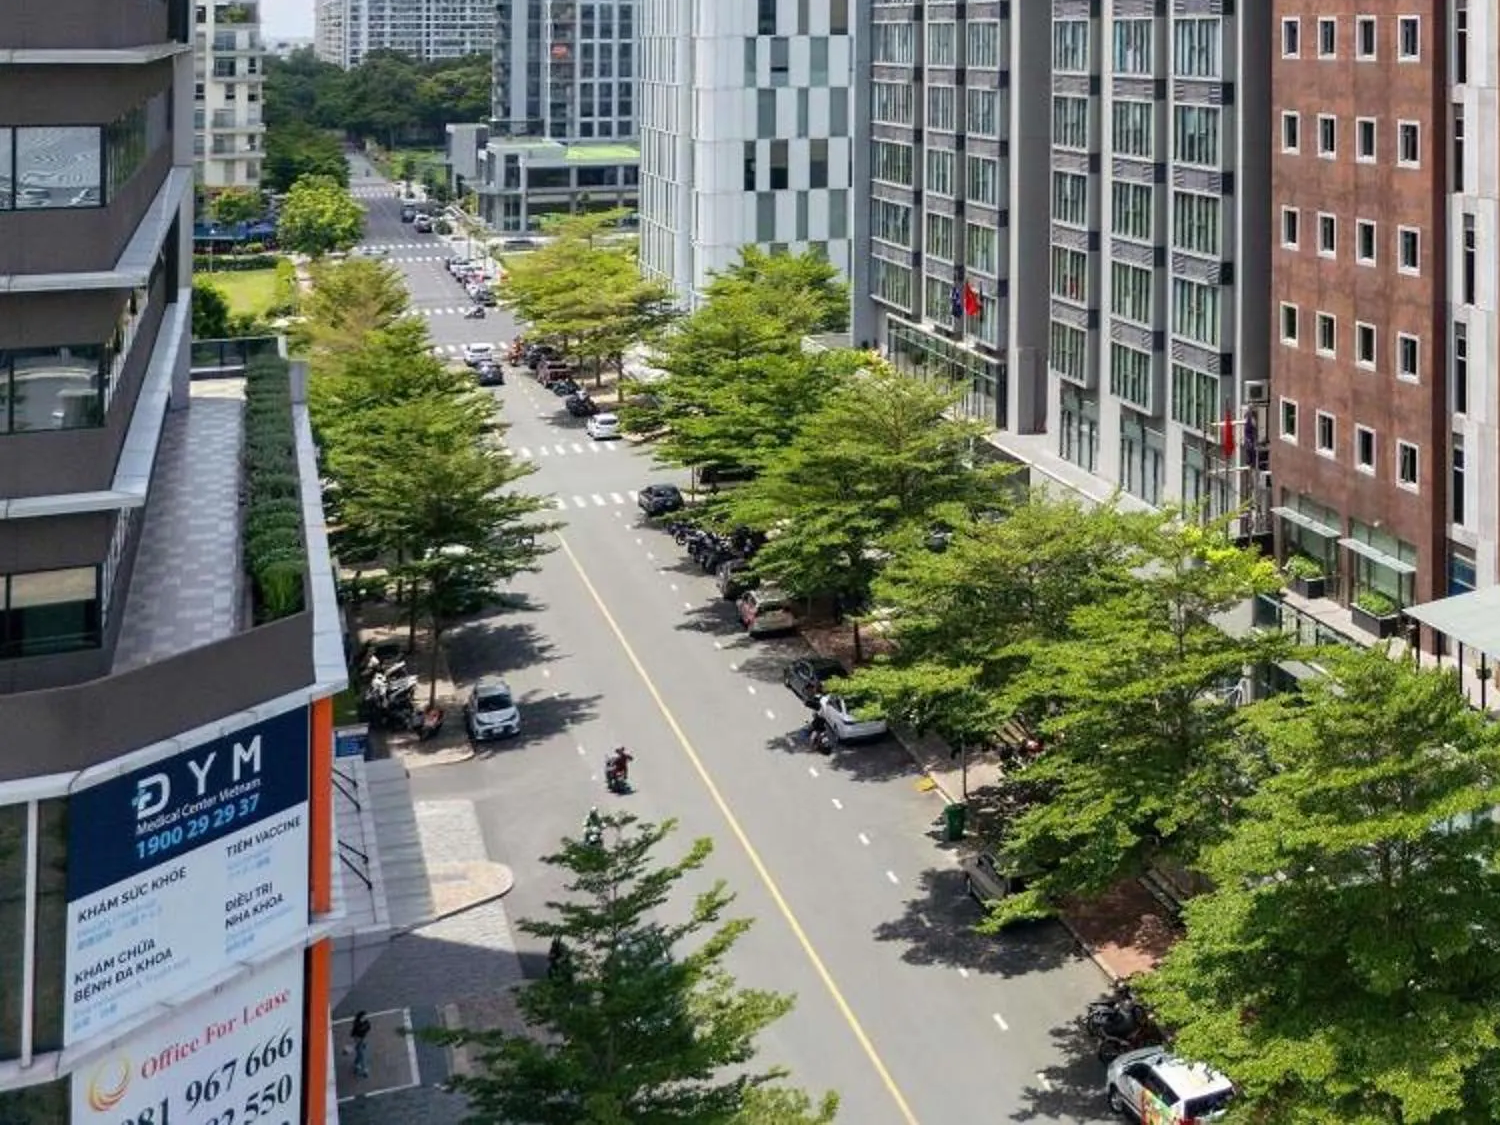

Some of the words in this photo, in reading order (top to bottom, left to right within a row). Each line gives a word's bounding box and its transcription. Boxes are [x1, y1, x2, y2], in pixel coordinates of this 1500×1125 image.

[136, 808, 181, 836] Medical
[182, 795, 217, 817] Center
[219, 778, 261, 802] Vietnam
[137, 825, 183, 859] 1900
[187, 814, 209, 839] 29
[213, 803, 235, 828] 29
[238, 793, 259, 817] 37
[141, 1037, 200, 1080] Office
[206, 1017, 238, 1045] For
[243, 987, 291, 1025] Lease
[185, 1057, 239, 1116] 967
[244, 1025, 294, 1077] 666
[243, 1073, 293, 1125] 550
